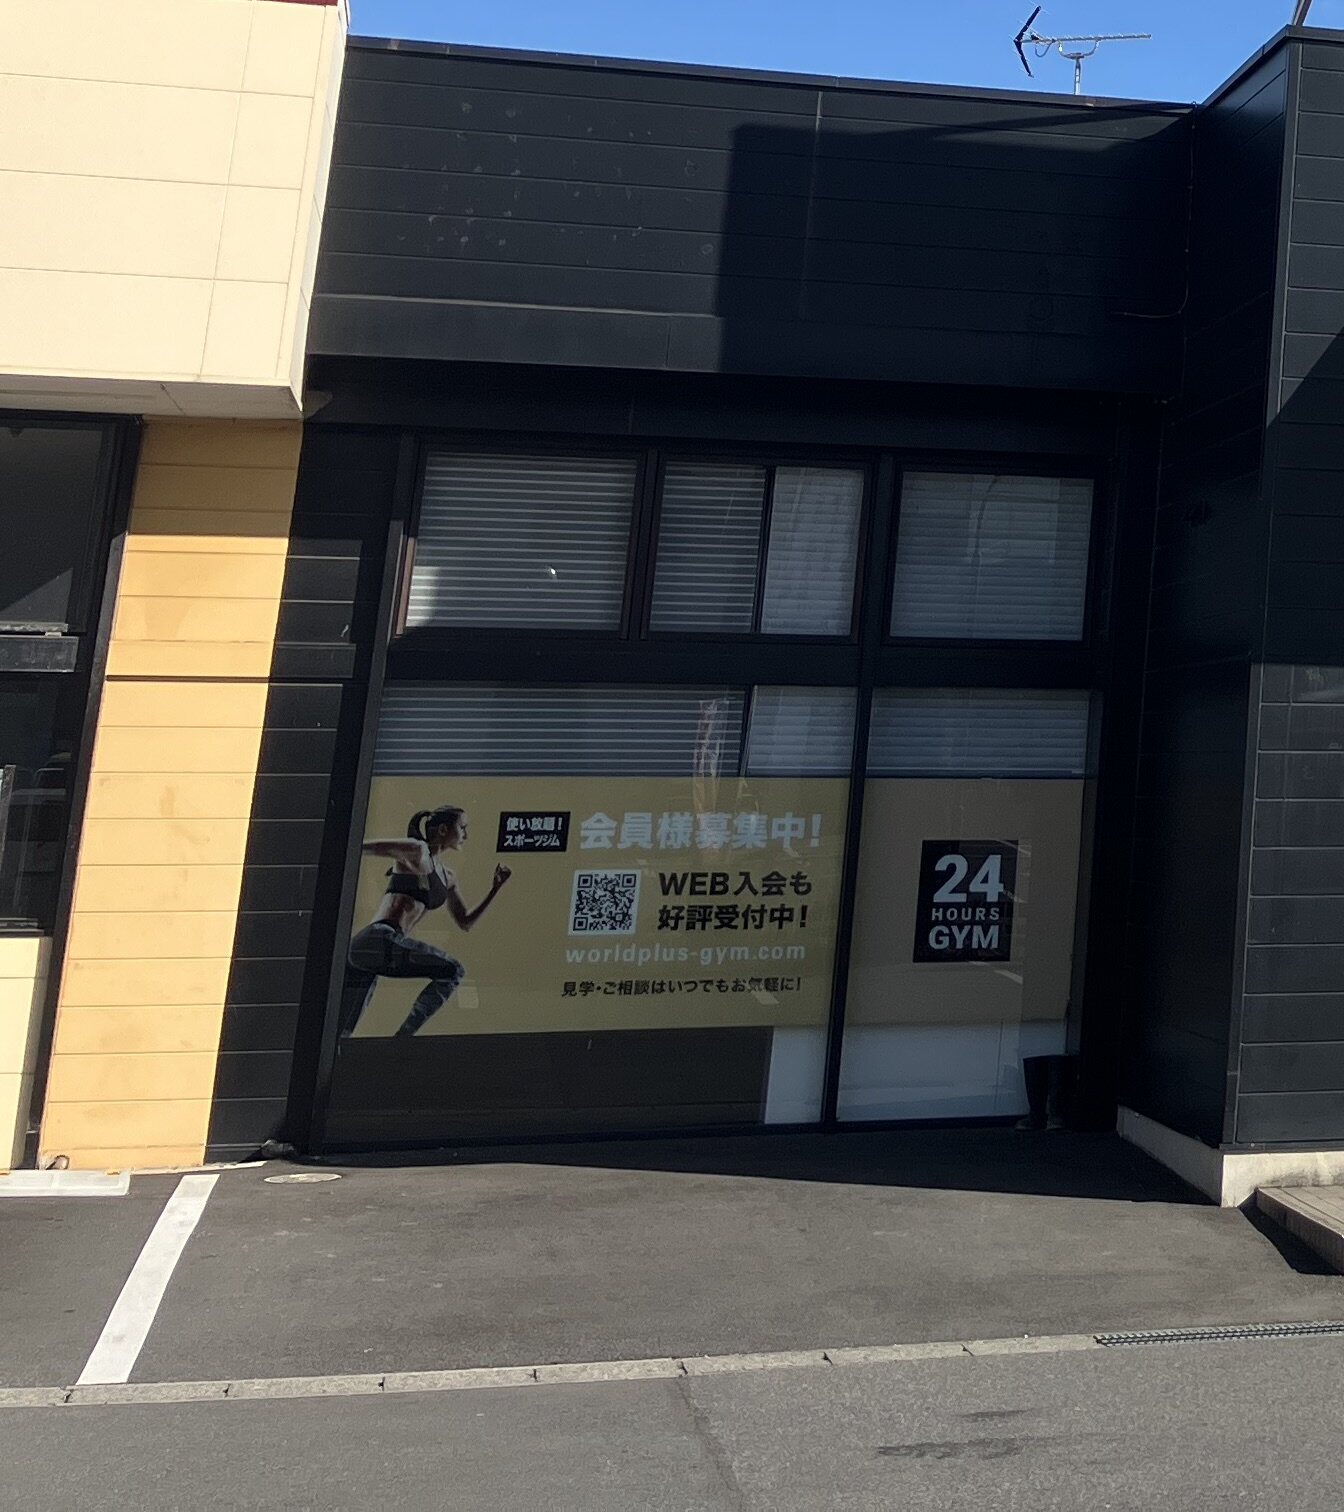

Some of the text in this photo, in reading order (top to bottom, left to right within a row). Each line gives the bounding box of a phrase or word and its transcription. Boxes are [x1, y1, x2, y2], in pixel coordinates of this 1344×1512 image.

[503, 833, 560, 847] スポーツジム
[580, 811, 823, 851] 会員様募集中!
[658, 870, 813, 896] WEB入会も
[933, 854, 1005, 904] 24
[657, 903, 809, 932] 好評受付中!
[931, 906, 1002, 922] HOURS
[928, 925, 1001, 951] GYM
[565, 941, 806, 967] worldplus-gym.com
